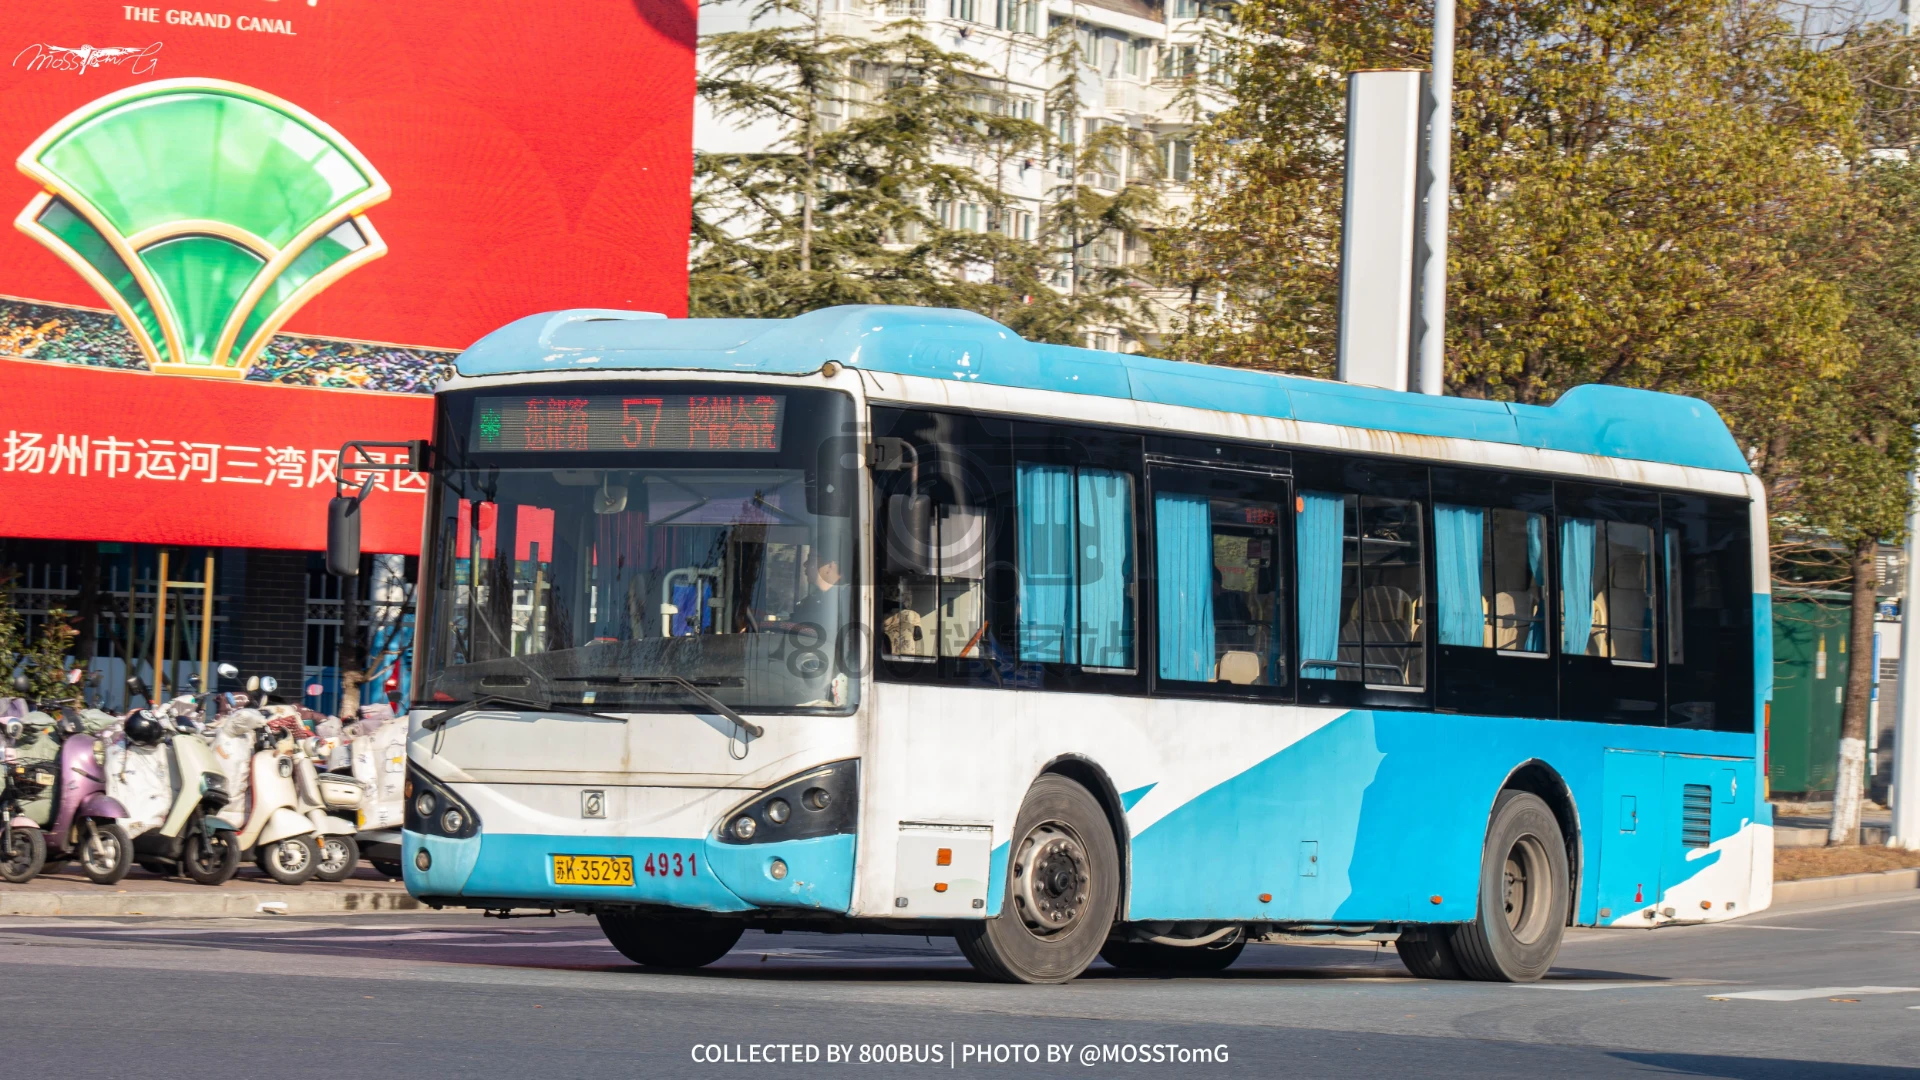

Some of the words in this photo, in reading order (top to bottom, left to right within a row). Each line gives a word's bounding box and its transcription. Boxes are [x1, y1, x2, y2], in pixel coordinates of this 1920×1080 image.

[122, 5, 160, 23] THE
[165, 9, 232, 29] GRAND
[236, 15, 297, 35] CANAL
[621, 398, 663, 448] 57
[687, 395, 777, 423] 扬州大学
[2, 430, 427, 493] 扬州市运河三湾风景区
[644, 852, 697, 877] 4931
